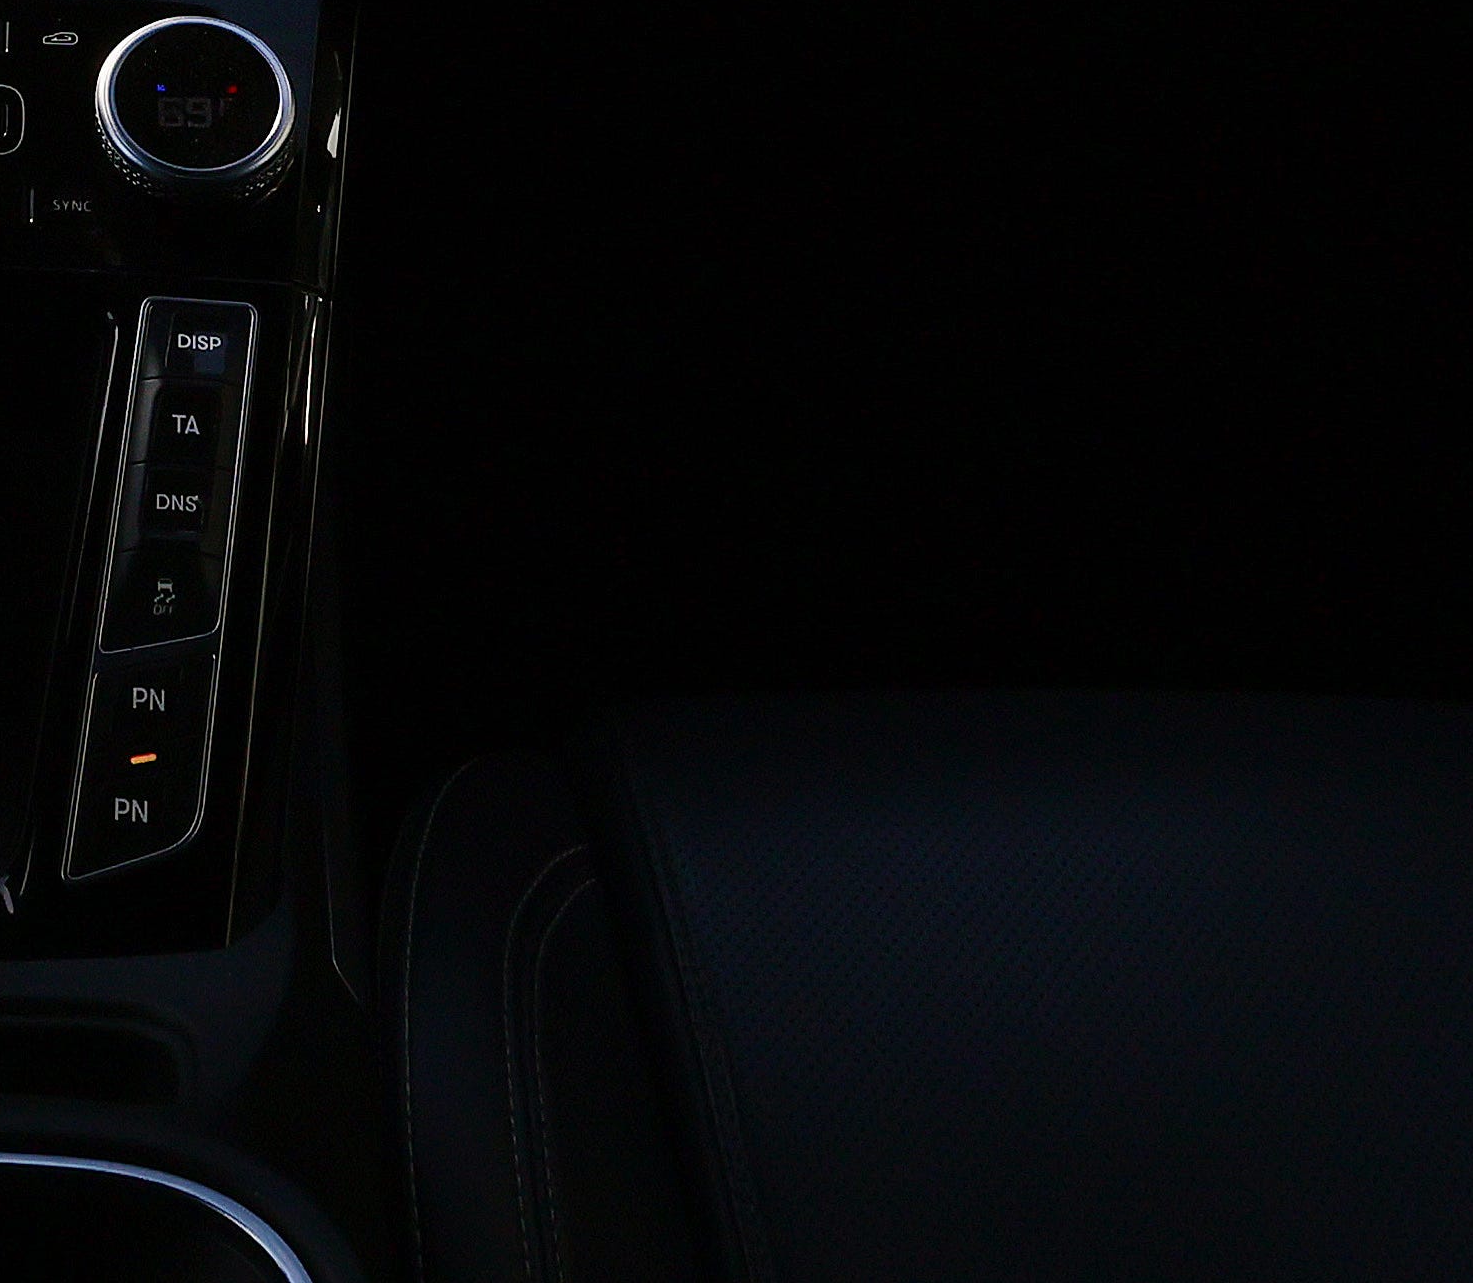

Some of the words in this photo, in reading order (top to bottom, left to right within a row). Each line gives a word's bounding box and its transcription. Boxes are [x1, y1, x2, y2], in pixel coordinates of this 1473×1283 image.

[53, 199, 93, 212] SYNC
[177, 333, 222, 351] DISP
[172, 415, 201, 436] TA
[132, 687, 167, 713] PN
[114, 797, 149, 823] PN
